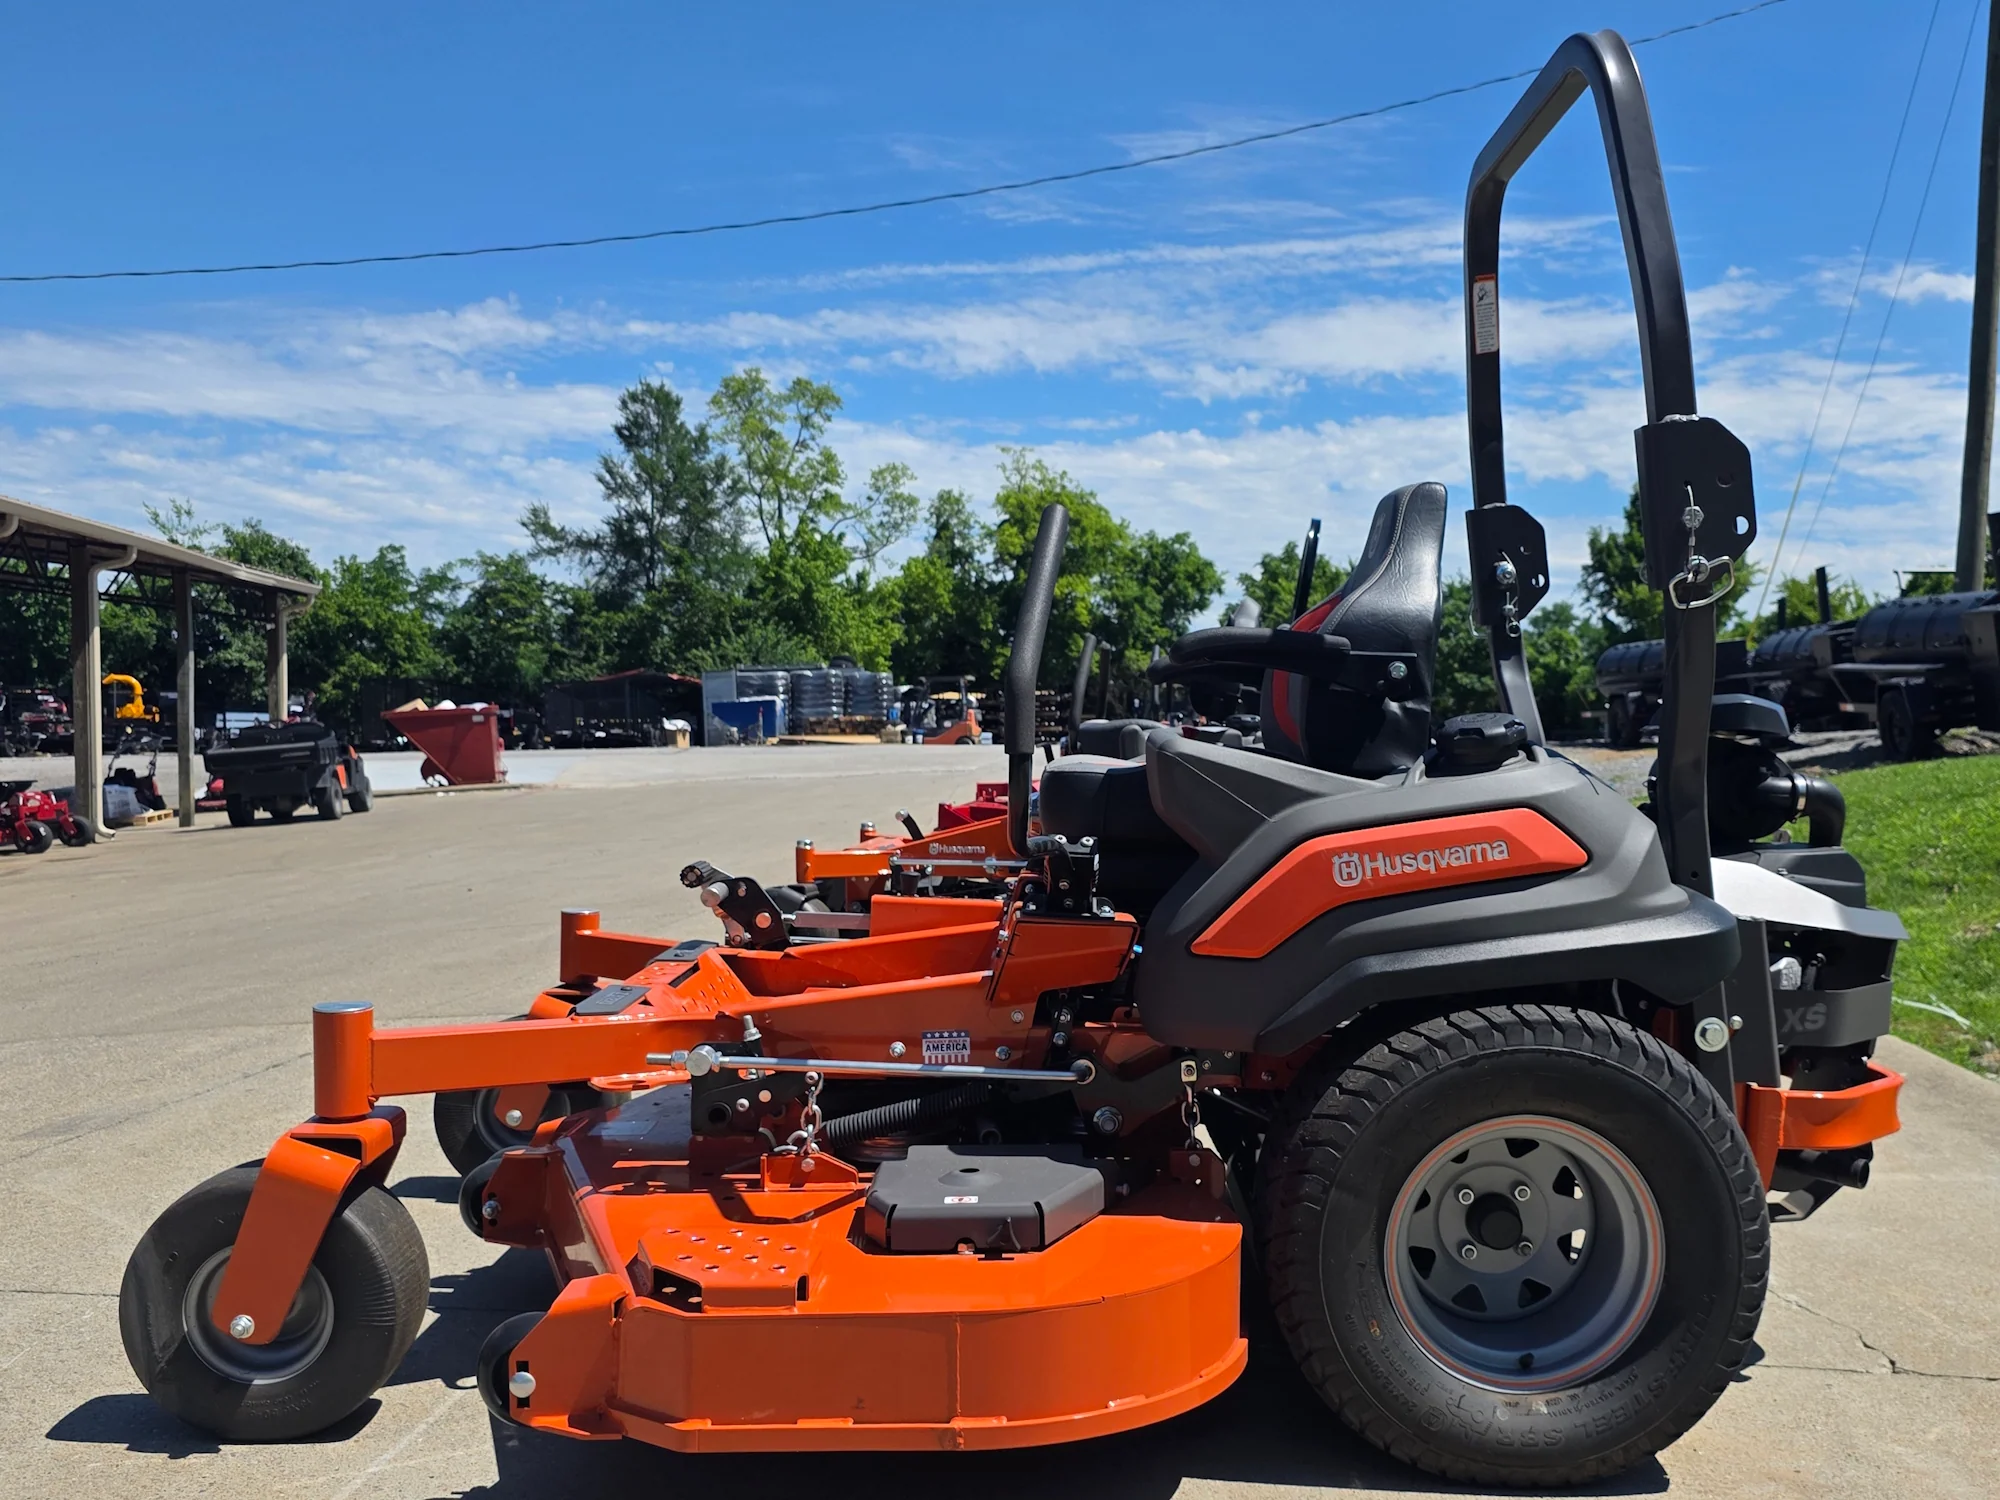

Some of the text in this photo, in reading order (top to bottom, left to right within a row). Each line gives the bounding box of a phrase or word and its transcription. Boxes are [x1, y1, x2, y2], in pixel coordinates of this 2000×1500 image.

[939, 844, 986, 855] Husqvarna
[1363, 839, 1510, 878] Husqvarna
[1780, 1002, 1828, 1033] XS
[925, 1042, 969, 1053] AMERICA
